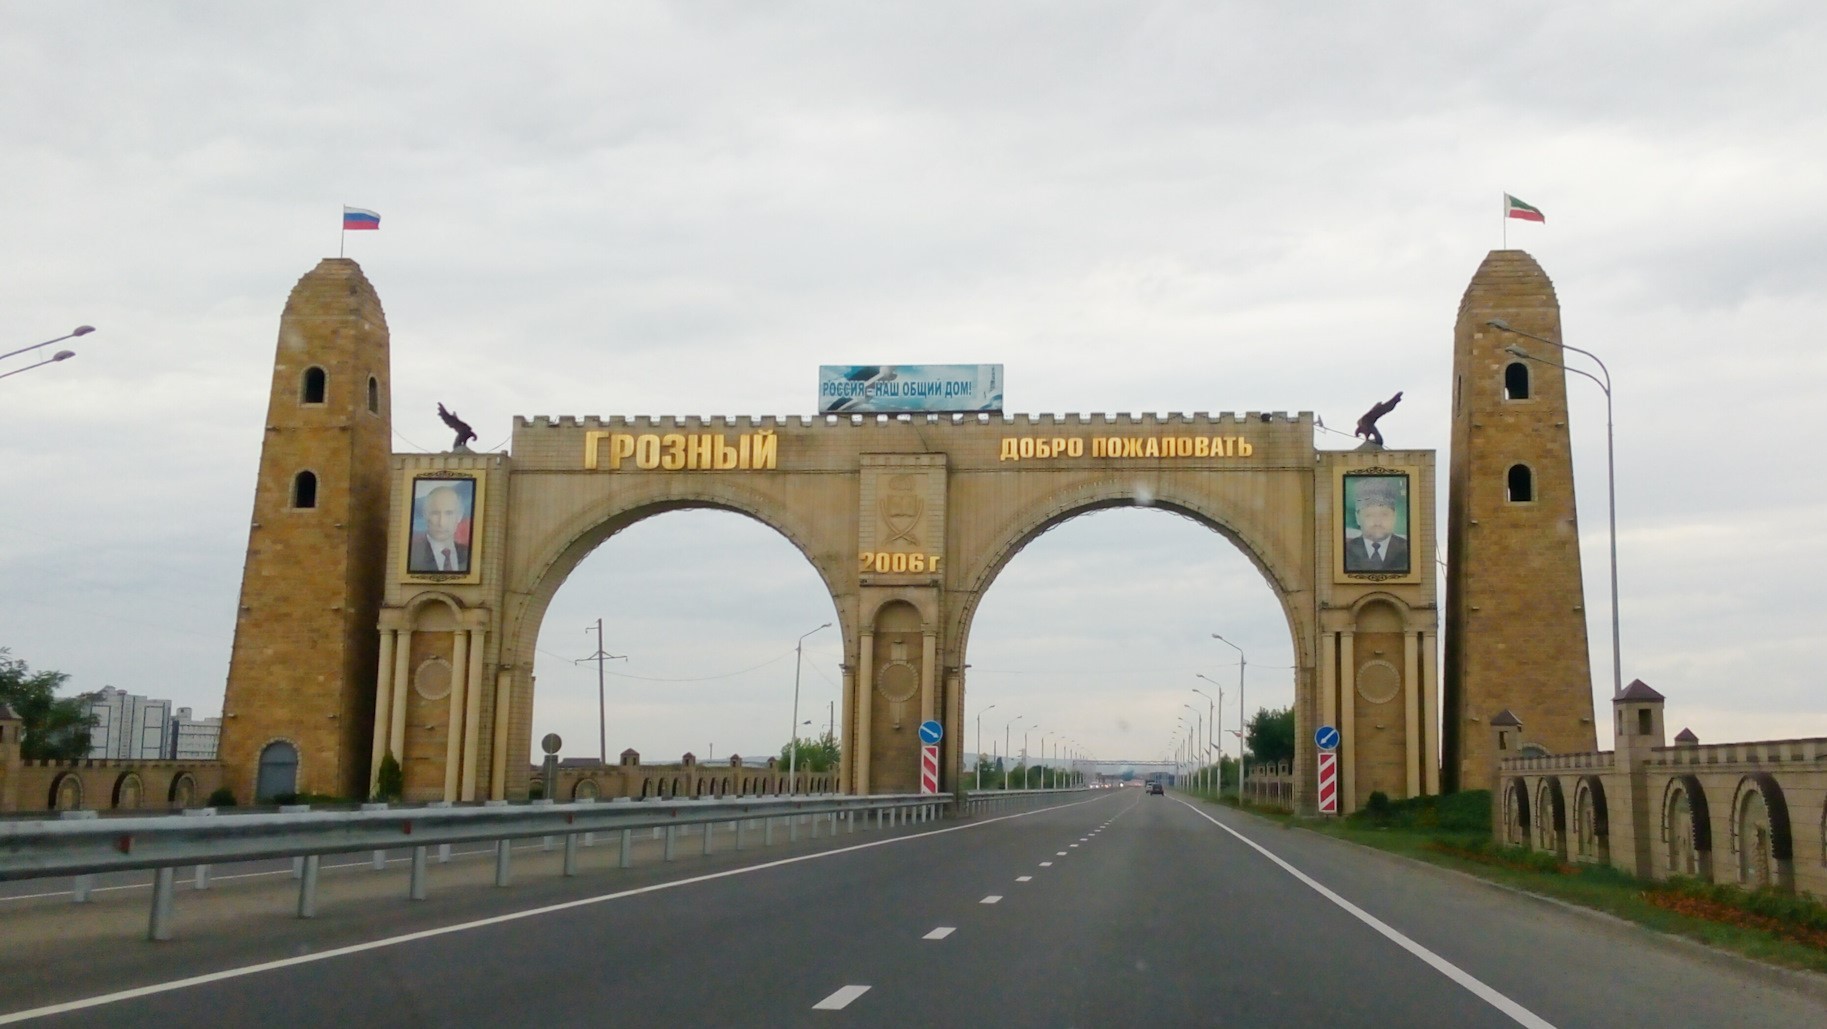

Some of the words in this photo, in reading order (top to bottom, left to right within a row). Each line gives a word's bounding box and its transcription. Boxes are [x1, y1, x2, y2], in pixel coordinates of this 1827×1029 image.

[822, 380, 865, 397] РОССИЯ
[875, 381, 899, 397] НАШ
[902, 378, 942, 398] ОБЩИЙ
[945, 381, 972, 398] ДОМ!
[584, 429, 778, 470] ГРОЗНЫЙ
[1000, 437, 1084, 461] ДОБРО
[1092, 436, 1253, 458] ПОЖАЛОВАТЬ
[860, 552, 924, 573] 2006
